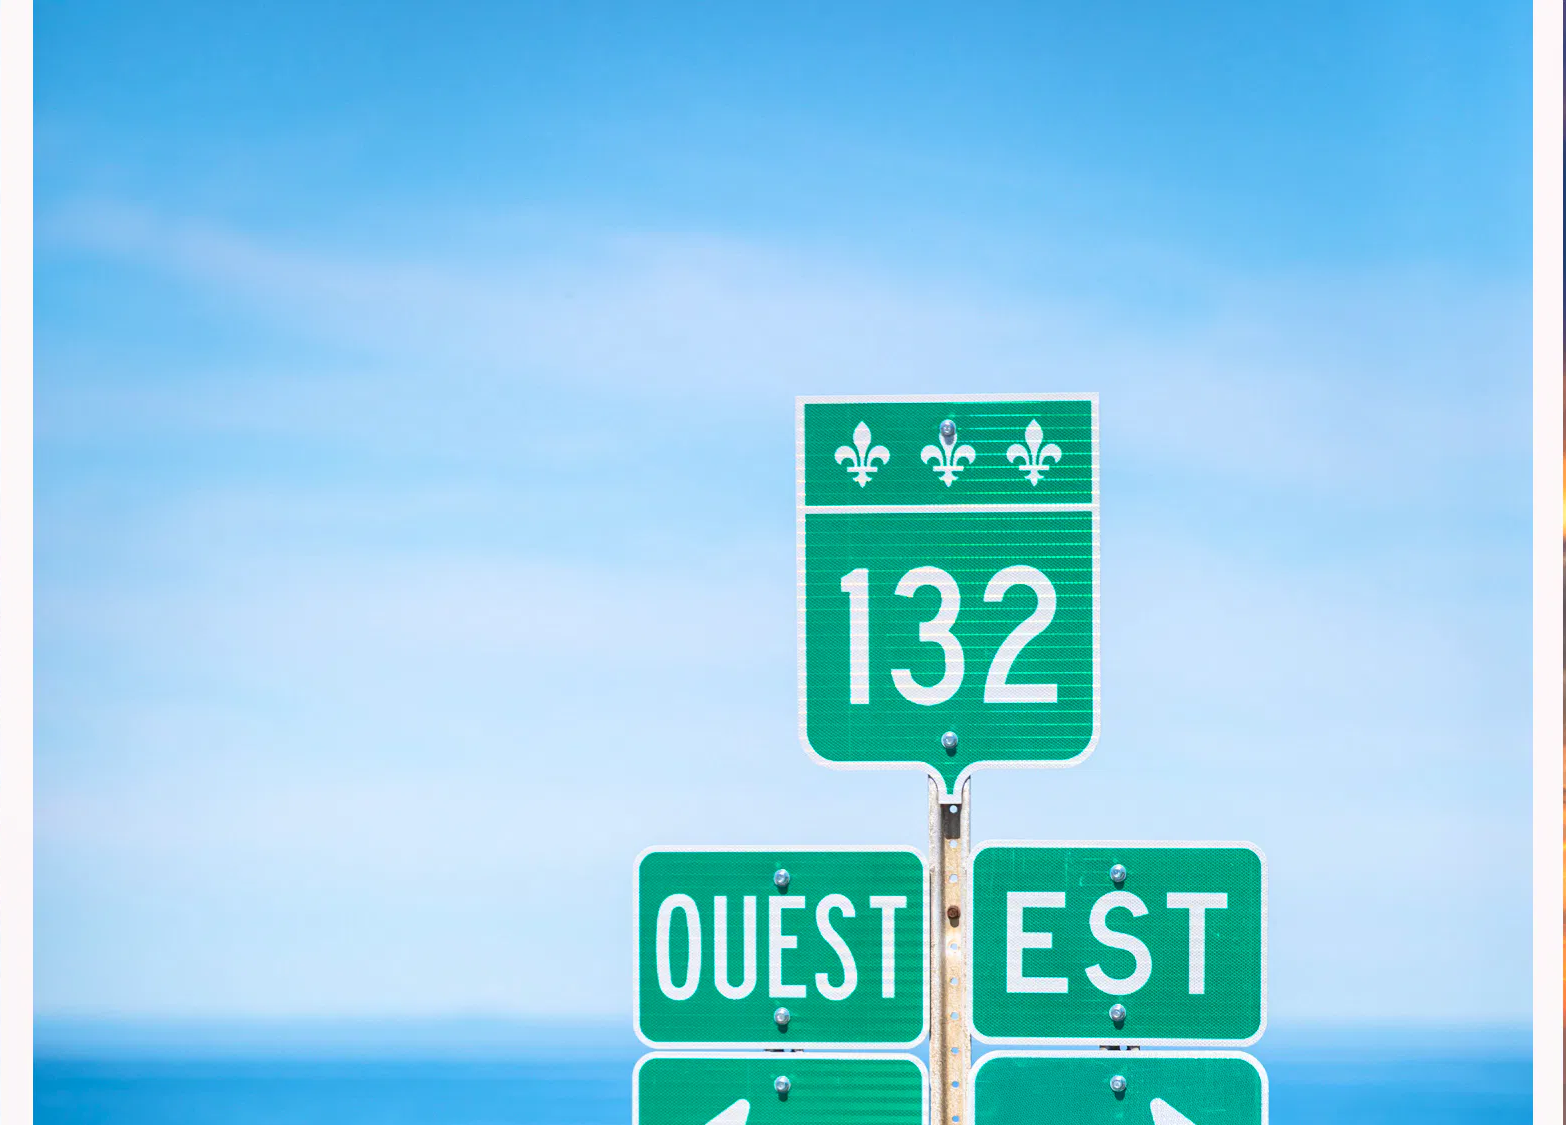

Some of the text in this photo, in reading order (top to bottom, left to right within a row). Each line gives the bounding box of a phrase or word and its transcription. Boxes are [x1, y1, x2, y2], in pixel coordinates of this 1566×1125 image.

[840, 564, 1058, 706] 132
[656, 893, 908, 1001] OUEST
[1006, 890, 1228, 996] EST
